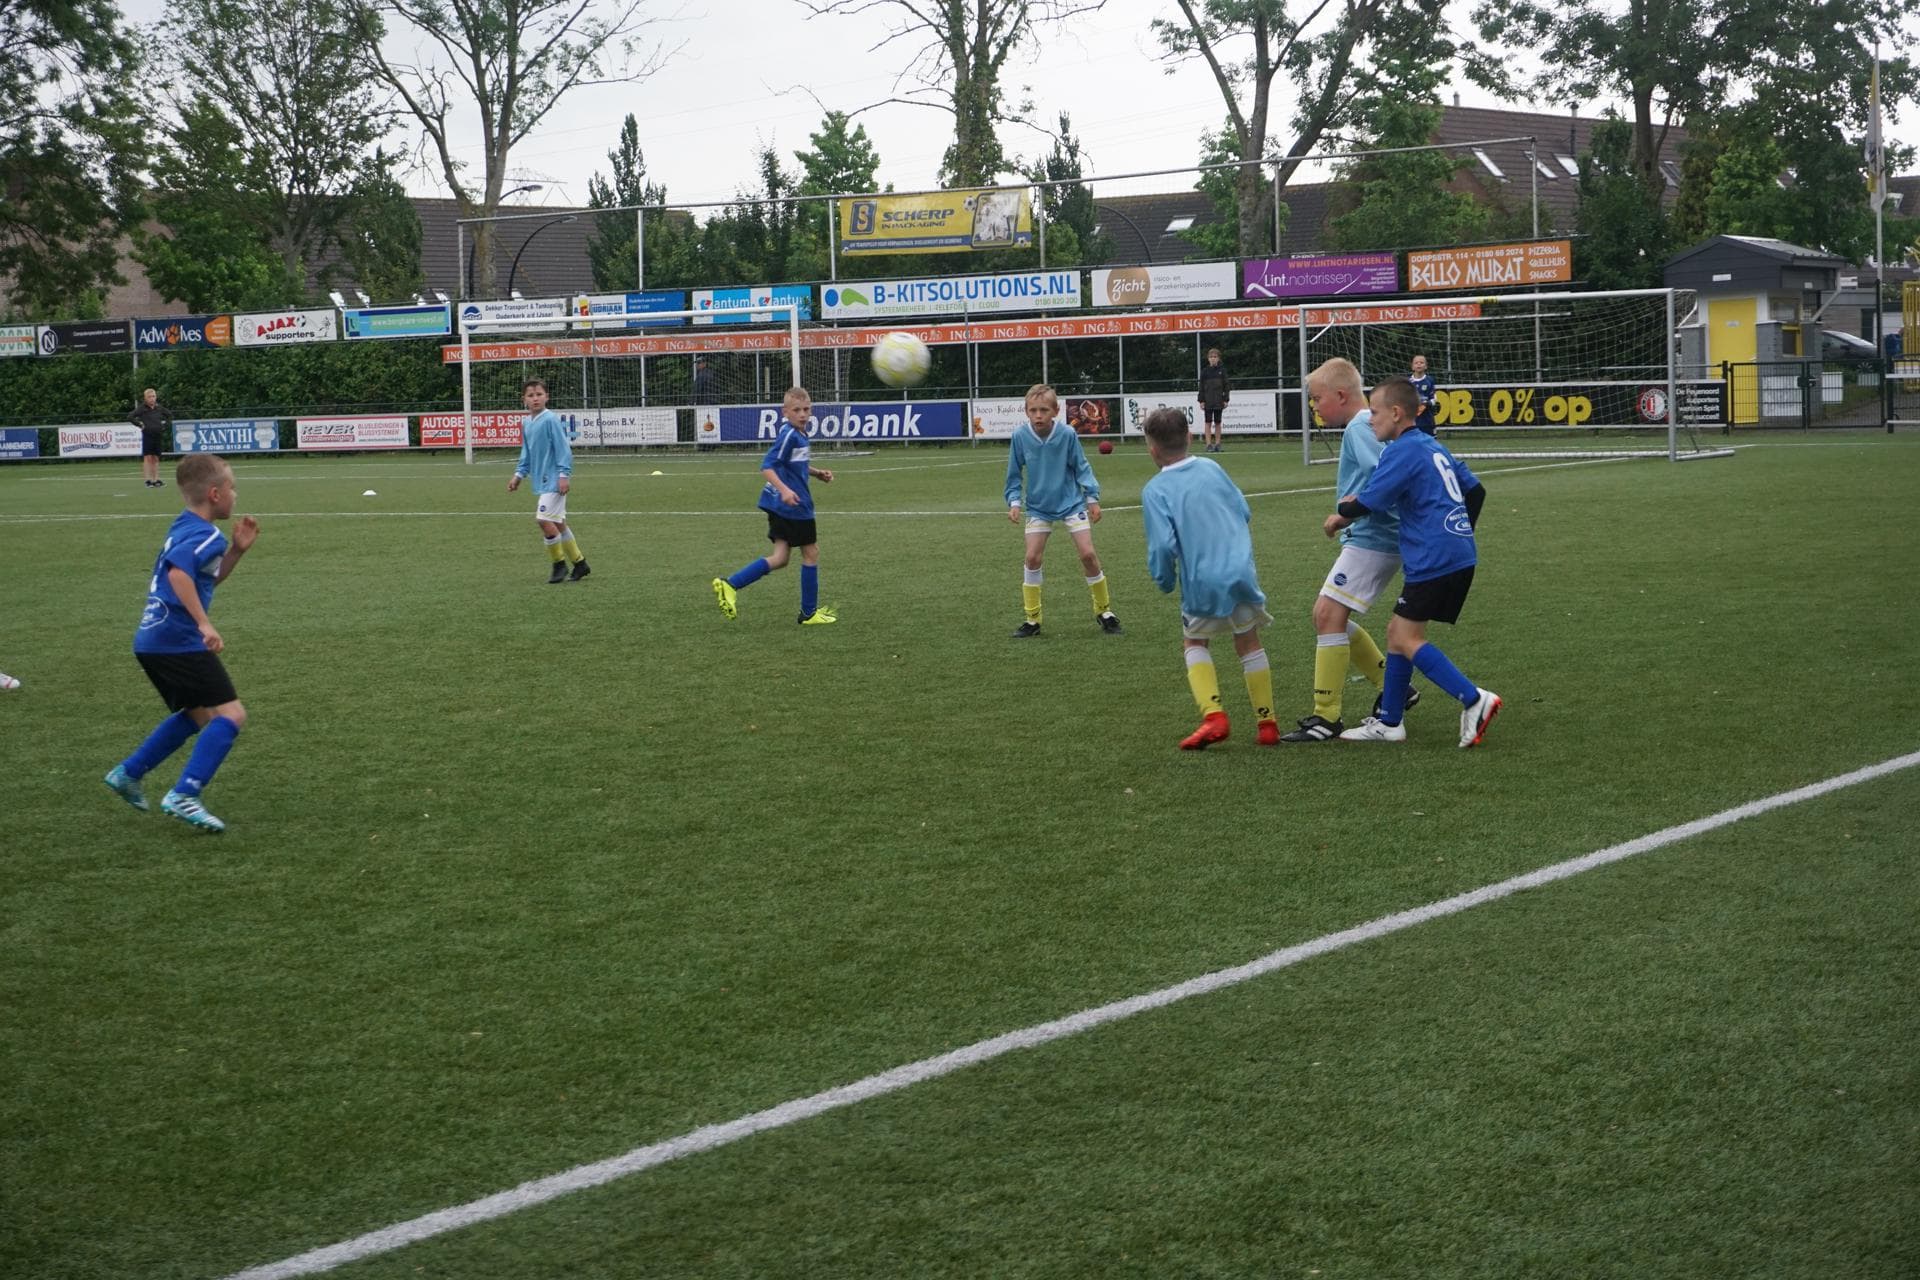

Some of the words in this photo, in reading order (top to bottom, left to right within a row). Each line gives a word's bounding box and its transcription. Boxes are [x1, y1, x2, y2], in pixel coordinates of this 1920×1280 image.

[881, 208, 955, 222] SCHERP
[881, 222, 891, 230] IN
[1505, 247, 1524, 256] 2074
[1528, 246, 1560, 256] PIZZERIA
[1288, 255, 1395, 269] WWW.LINTNOTARISSEN.NL
[1411, 261, 1462, 289] BELLO
[1466, 256, 1524, 285] MURAT
[1528, 269, 1558, 281] SNACKS
[874, 275, 1077, 304] B-KITSOLUTIONS.NL
[1112, 279, 1146, 302] Zicht
[504, 303, 529, 311] Transport
[1431, 306, 1457, 318] ING
[1277, 313, 1300, 325] ING
[1379, 309, 1404, 320] ING
[257, 315, 297, 337] AJAX
[1129, 320, 1152, 331] ING
[1179, 318, 1202, 329] ING
[1227, 316, 1251, 327] ING
[993, 327, 1014, 338] ING
[1038, 325, 1060, 336] ING
[1083, 323, 1105, 334] ING
[265, 330, 315, 341] supporters
[824, 335, 843, 345] ING
[627, 342, 646, 352] ING
[665, 340, 684, 351] ING
[742, 337, 762, 347] ING
[481, 349, 499, 358] ING
[516, 347, 534, 357] ING
[1686, 388, 1720, 396] Feyenoord
[1489, 389, 1535, 424] 0%
[1543, 395, 1593, 425] op
[422, 415, 494, 428] AUTOBERIJF
[583, 418, 594, 427] De
[302, 423, 355, 435] REVER
[486, 429, 497, 438] 68
[499, 428, 521, 437] 1350
[61, 430, 113, 445] RODENBURG
[198, 428, 253, 445] XANTHI
[1432, 452, 1464, 503] 6
